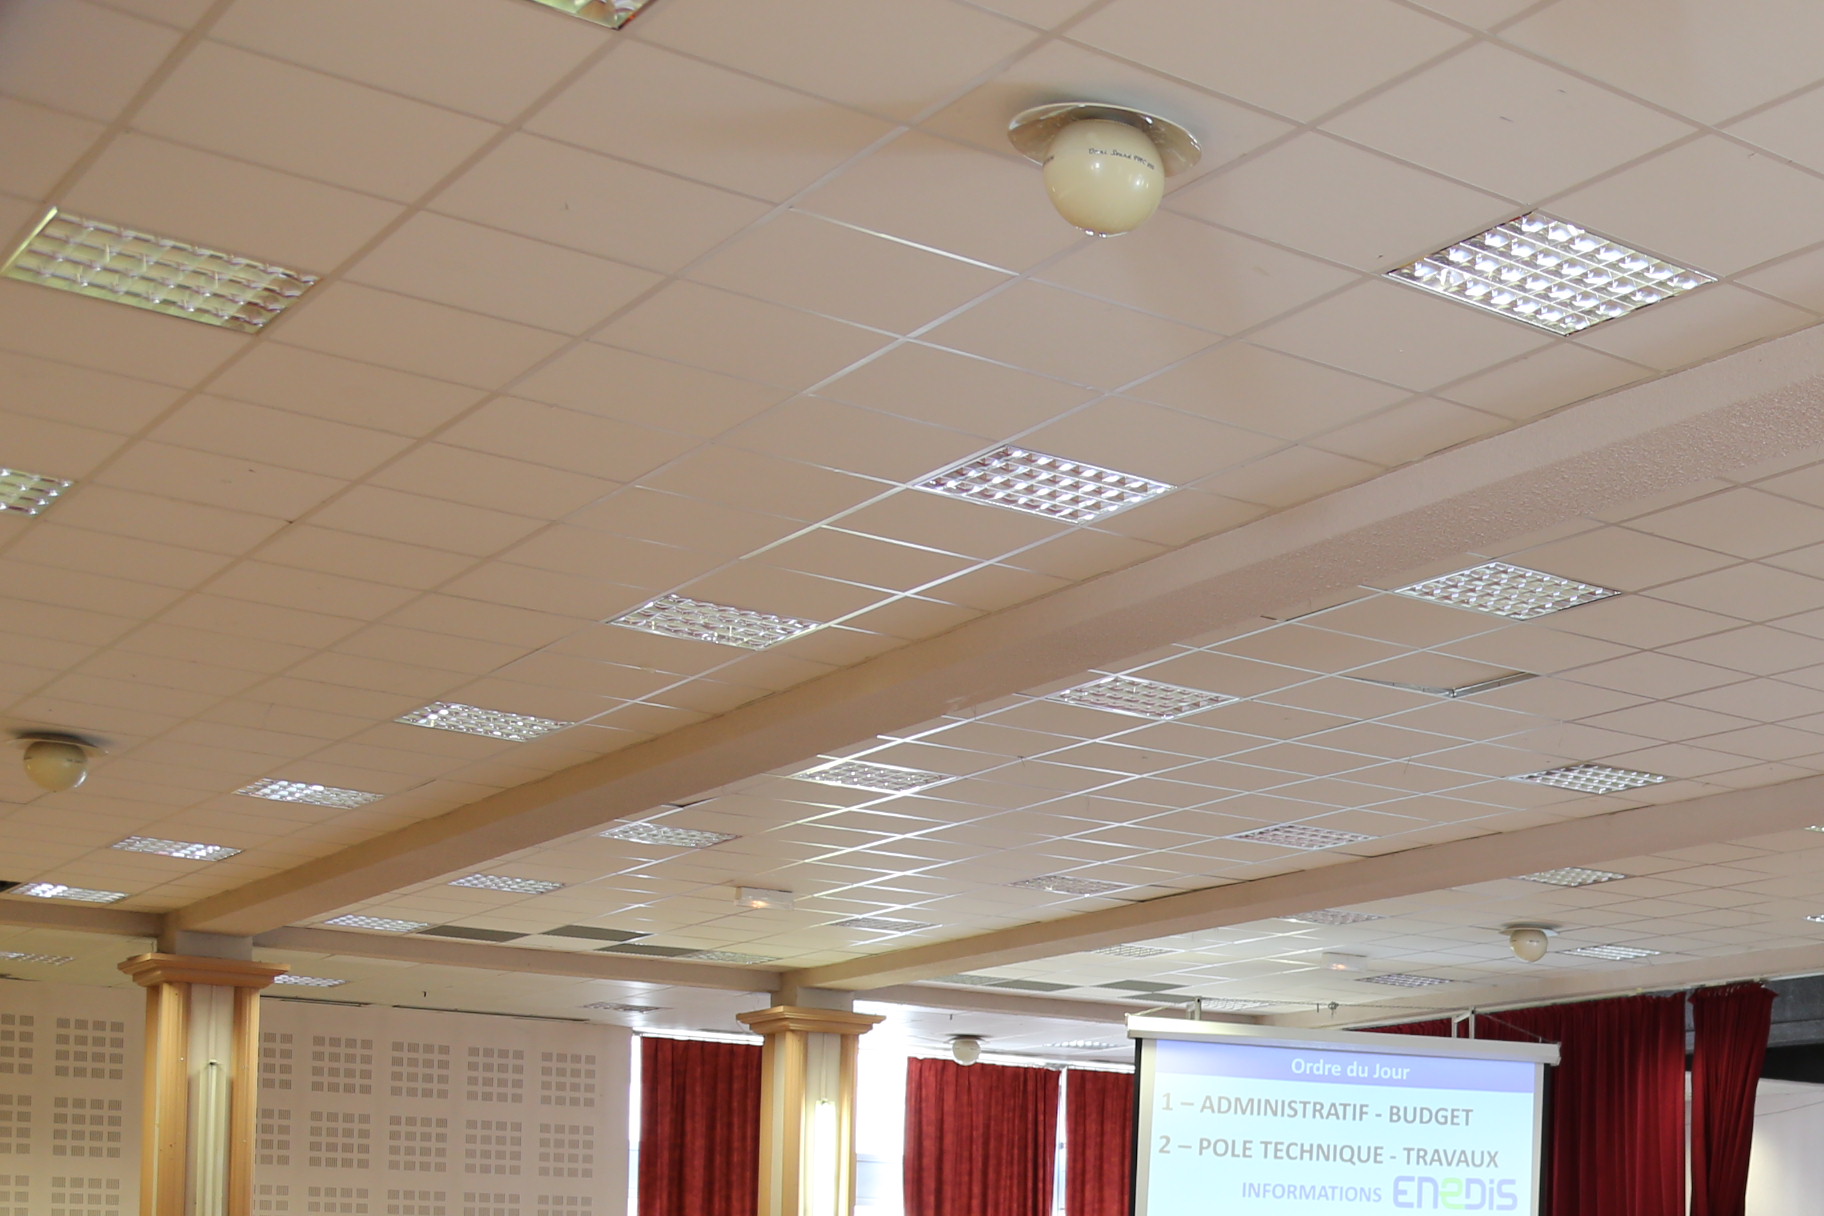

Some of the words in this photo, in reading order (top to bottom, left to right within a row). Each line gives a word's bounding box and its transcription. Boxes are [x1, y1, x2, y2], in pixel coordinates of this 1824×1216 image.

[1291, 1058, 1342, 1077] Ordre
[1346, 1060, 1369, 1078] du
[1372, 1063, 1411, 1080] Jour
[1161, 1092, 1174, 1112] 1
[1199, 1095, 1370, 1123] ADMINISTRATIF
[1388, 1105, 1474, 1127] BUDGET
[1158, 1134, 1171, 1155] 2
[1198, 1137, 1254, 1159] POLE
[1259, 1140, 1385, 1166] TECHNIQUE
[1402, 1147, 1499, 1169] TRAVAUX
[1242, 1181, 1383, 1203] INFORMATIONS
